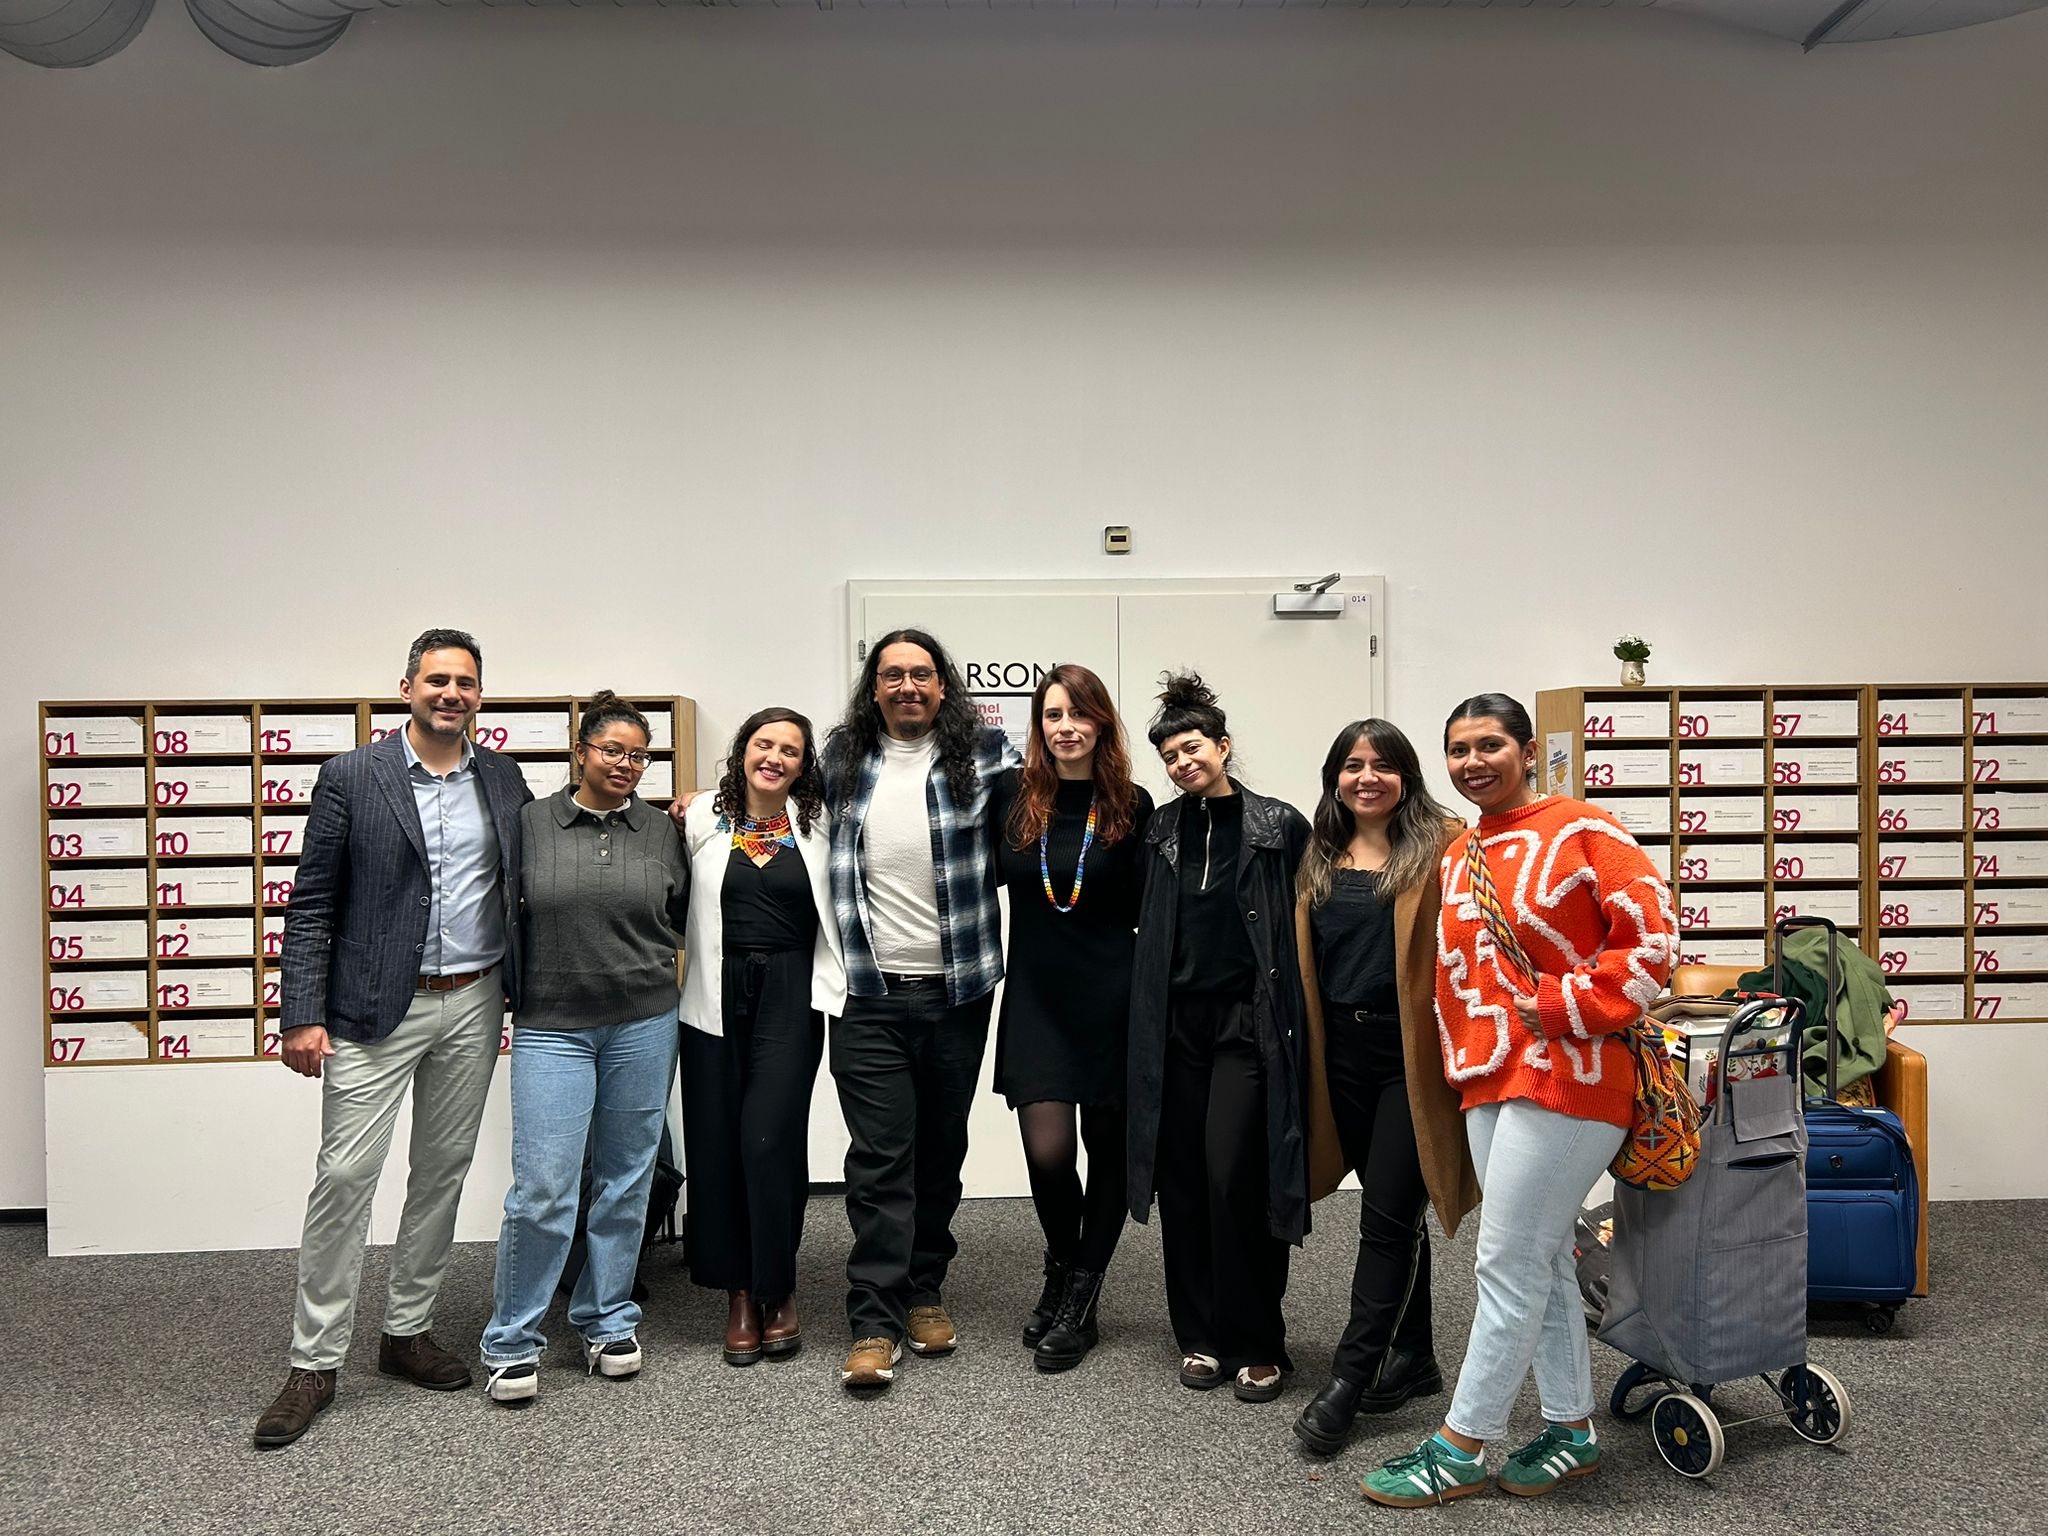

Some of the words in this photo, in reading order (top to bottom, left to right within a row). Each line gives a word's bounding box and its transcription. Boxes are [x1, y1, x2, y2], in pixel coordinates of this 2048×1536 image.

[1584, 716, 1615, 737] 44
[1679, 715, 1709, 736] 50
[1773, 714, 1802, 736] 57
[1878, 714, 1908, 735] 64
[1974, 712, 1998, 734] 71
[46, 731, 79, 755] 01
[154, 731, 188, 755] 08
[261, 729, 291, 752] 15
[476, 727, 508, 750] 29
[1585, 763, 1614, 785] 43
[1680, 763, 1705, 785] 51
[1774, 762, 1802, 784] 58
[1879, 760, 1907, 782] 65
[1974, 759, 2000, 781] 72
[48, 783, 81, 807] 02
[155, 781, 188, 805] 09
[262, 780, 293, 803] 16
[1680, 811, 1707, 833] 52
[1774, 809, 1802, 832] 59
[1879, 809, 1908, 831] 66
[1974, 807, 2000, 830] 73
[49, 834, 83, 858] 03
[156, 832, 189, 856] 10
[262, 831, 292, 854] 17
[1680, 858, 1708, 880] 53
[1774, 858, 1804, 880] 60
[1878, 856, 1907, 878] 67
[1974, 855, 1999, 878] 74
[50, 885, 84, 909] 04
[157, 883, 185, 907] 11
[262, 881, 293, 905] 18
[1680, 907, 1710, 928] 54
[1775, 905, 1796, 925] 61
[1880, 904, 1908, 926] 68
[1975, 903, 2000, 926] 75
[49, 936, 84, 961] 05
[157, 933, 190, 958] 12
[1879, 950, 1908, 973] 69
[1975, 950, 1999, 973] 76
[50, 987, 85, 1011] 06
[157, 984, 190, 1008] 13
[263, 982, 280, 1005] 2
[1975, 997, 2001, 1019] 77
[51, 1038, 85, 1062] 07
[159, 1035, 190, 1058] 14
[264, 1033, 280, 1056] 2
